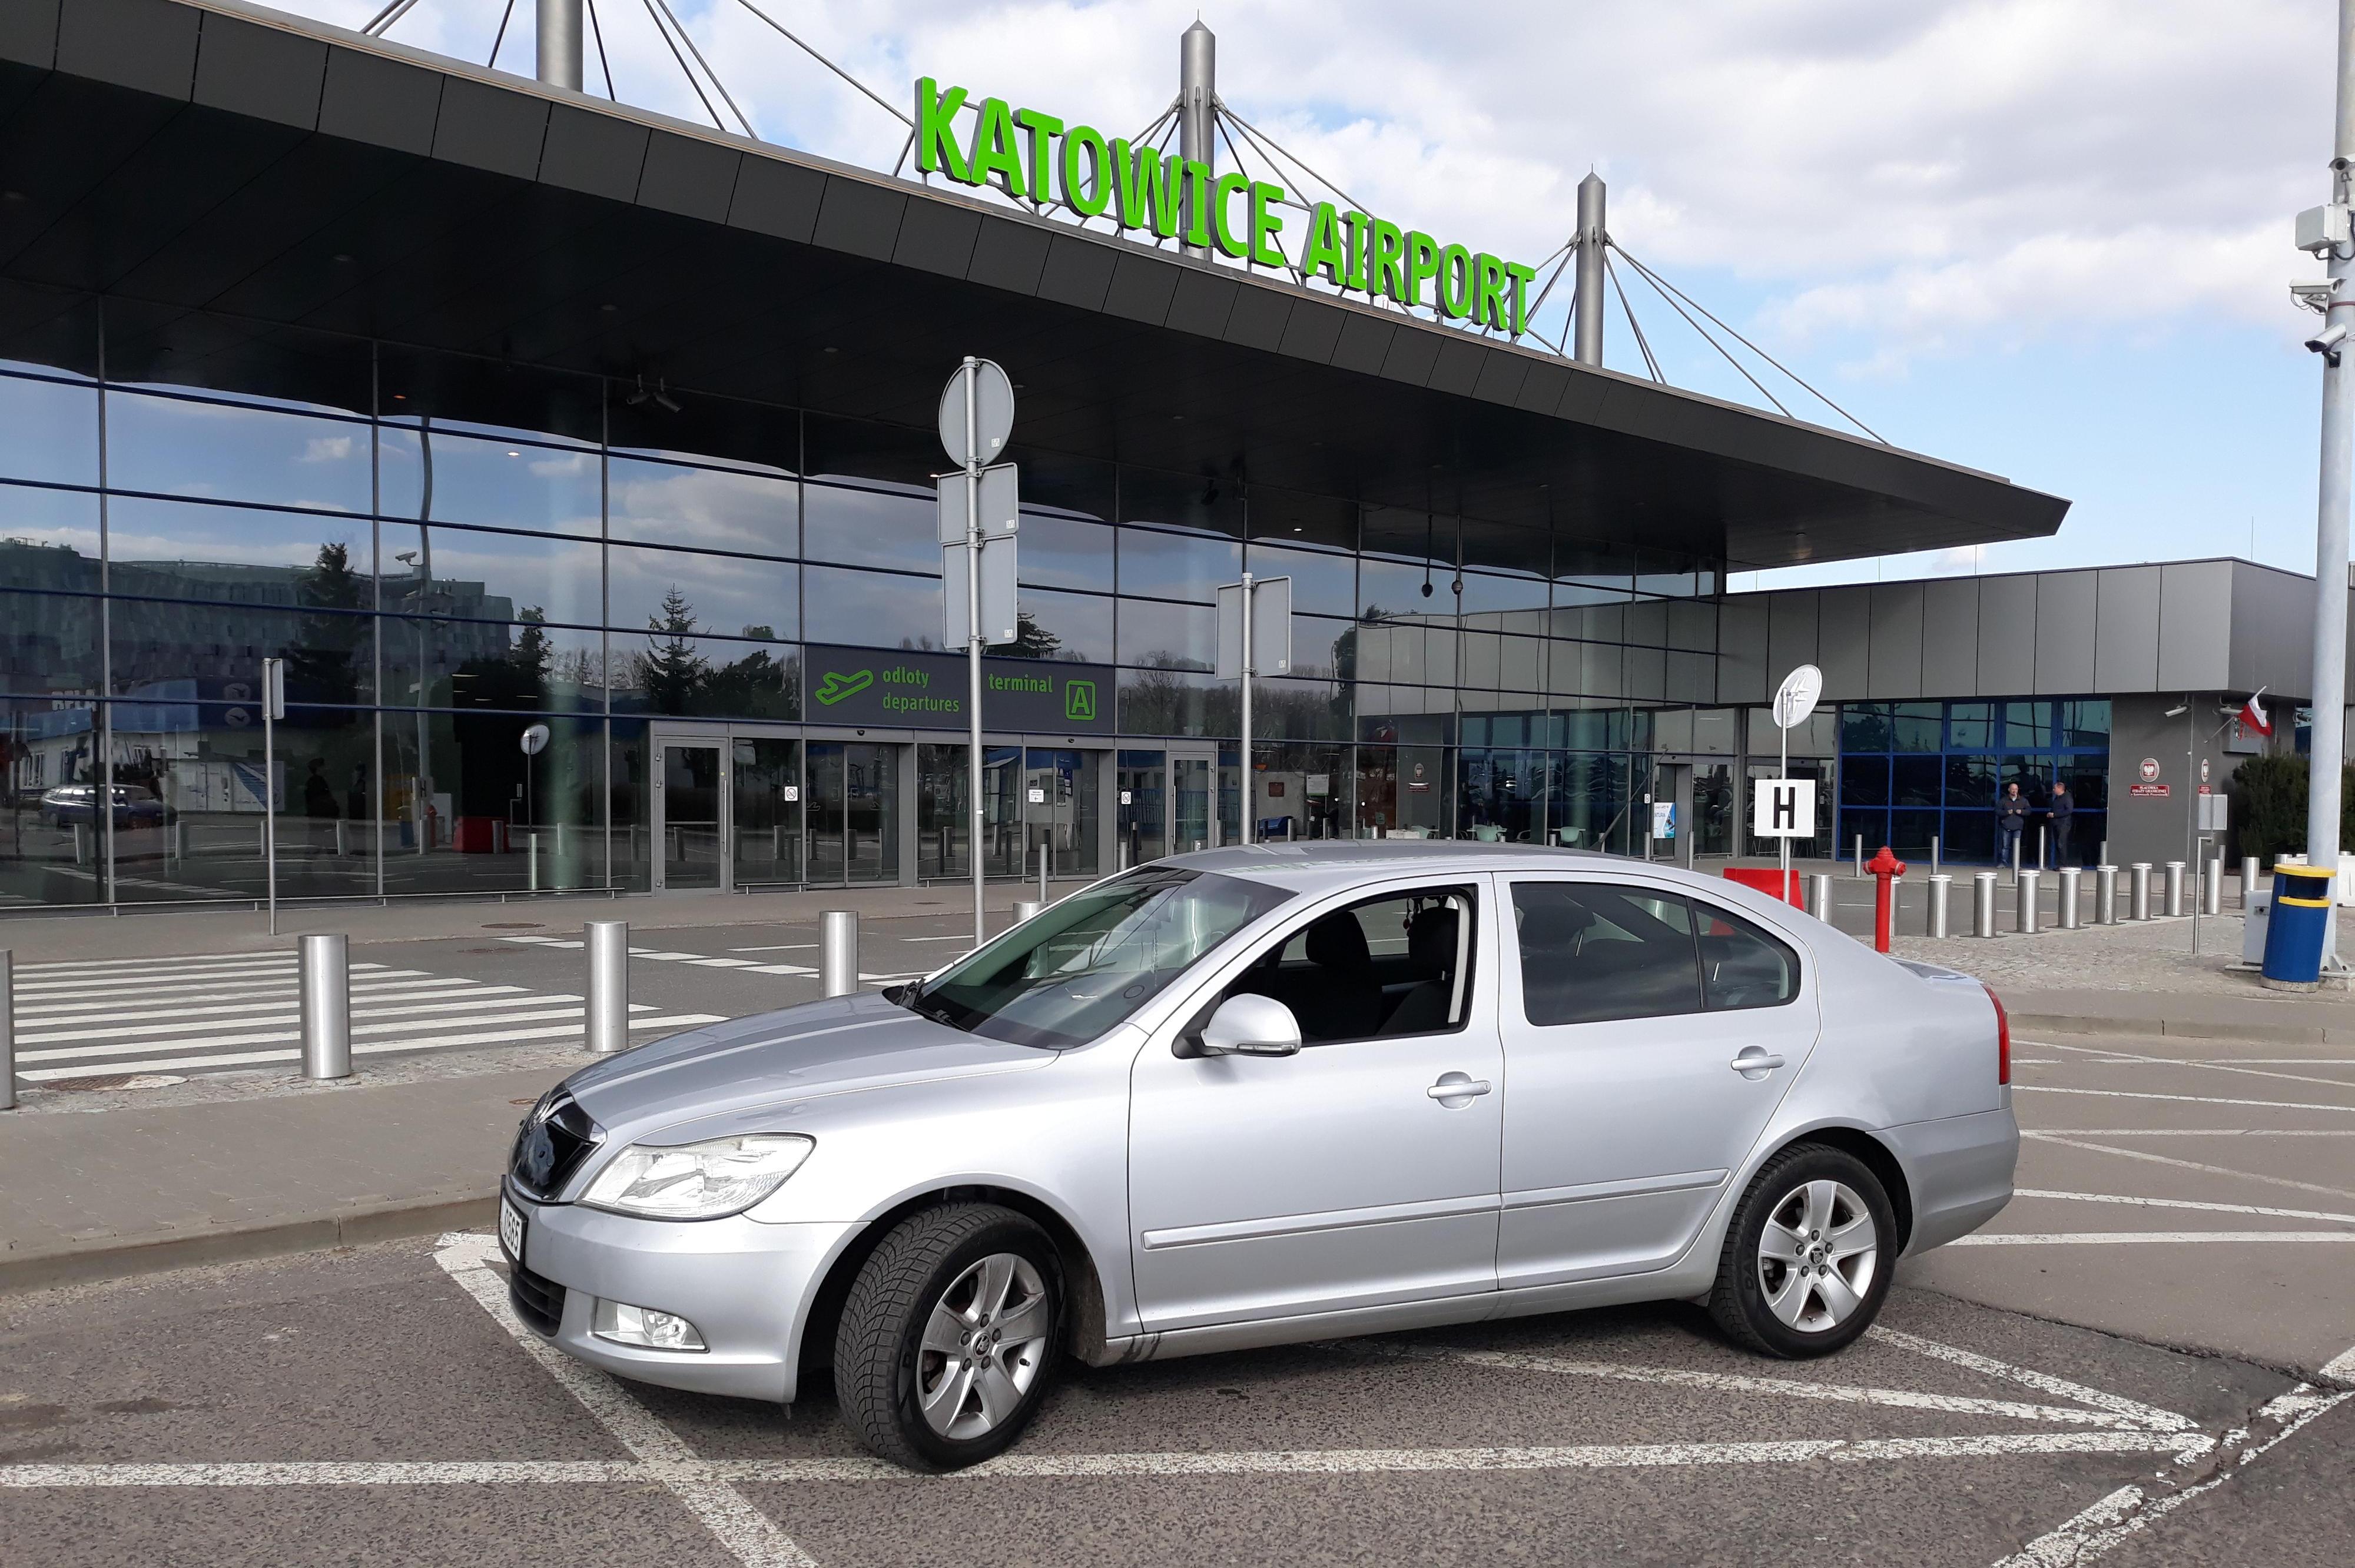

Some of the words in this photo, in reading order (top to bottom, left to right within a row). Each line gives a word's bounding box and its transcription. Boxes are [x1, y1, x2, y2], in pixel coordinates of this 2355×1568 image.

[916, 77, 1285, 267] KATOWICE
[1301, 202, 1535, 334] AIRPORT
[883, 666, 929, 688] odloty
[989, 673, 1053, 693] terminal
[1072, 686, 1090, 715] A
[883, 692, 960, 713] departures
[1773, 787, 1795, 829] H
